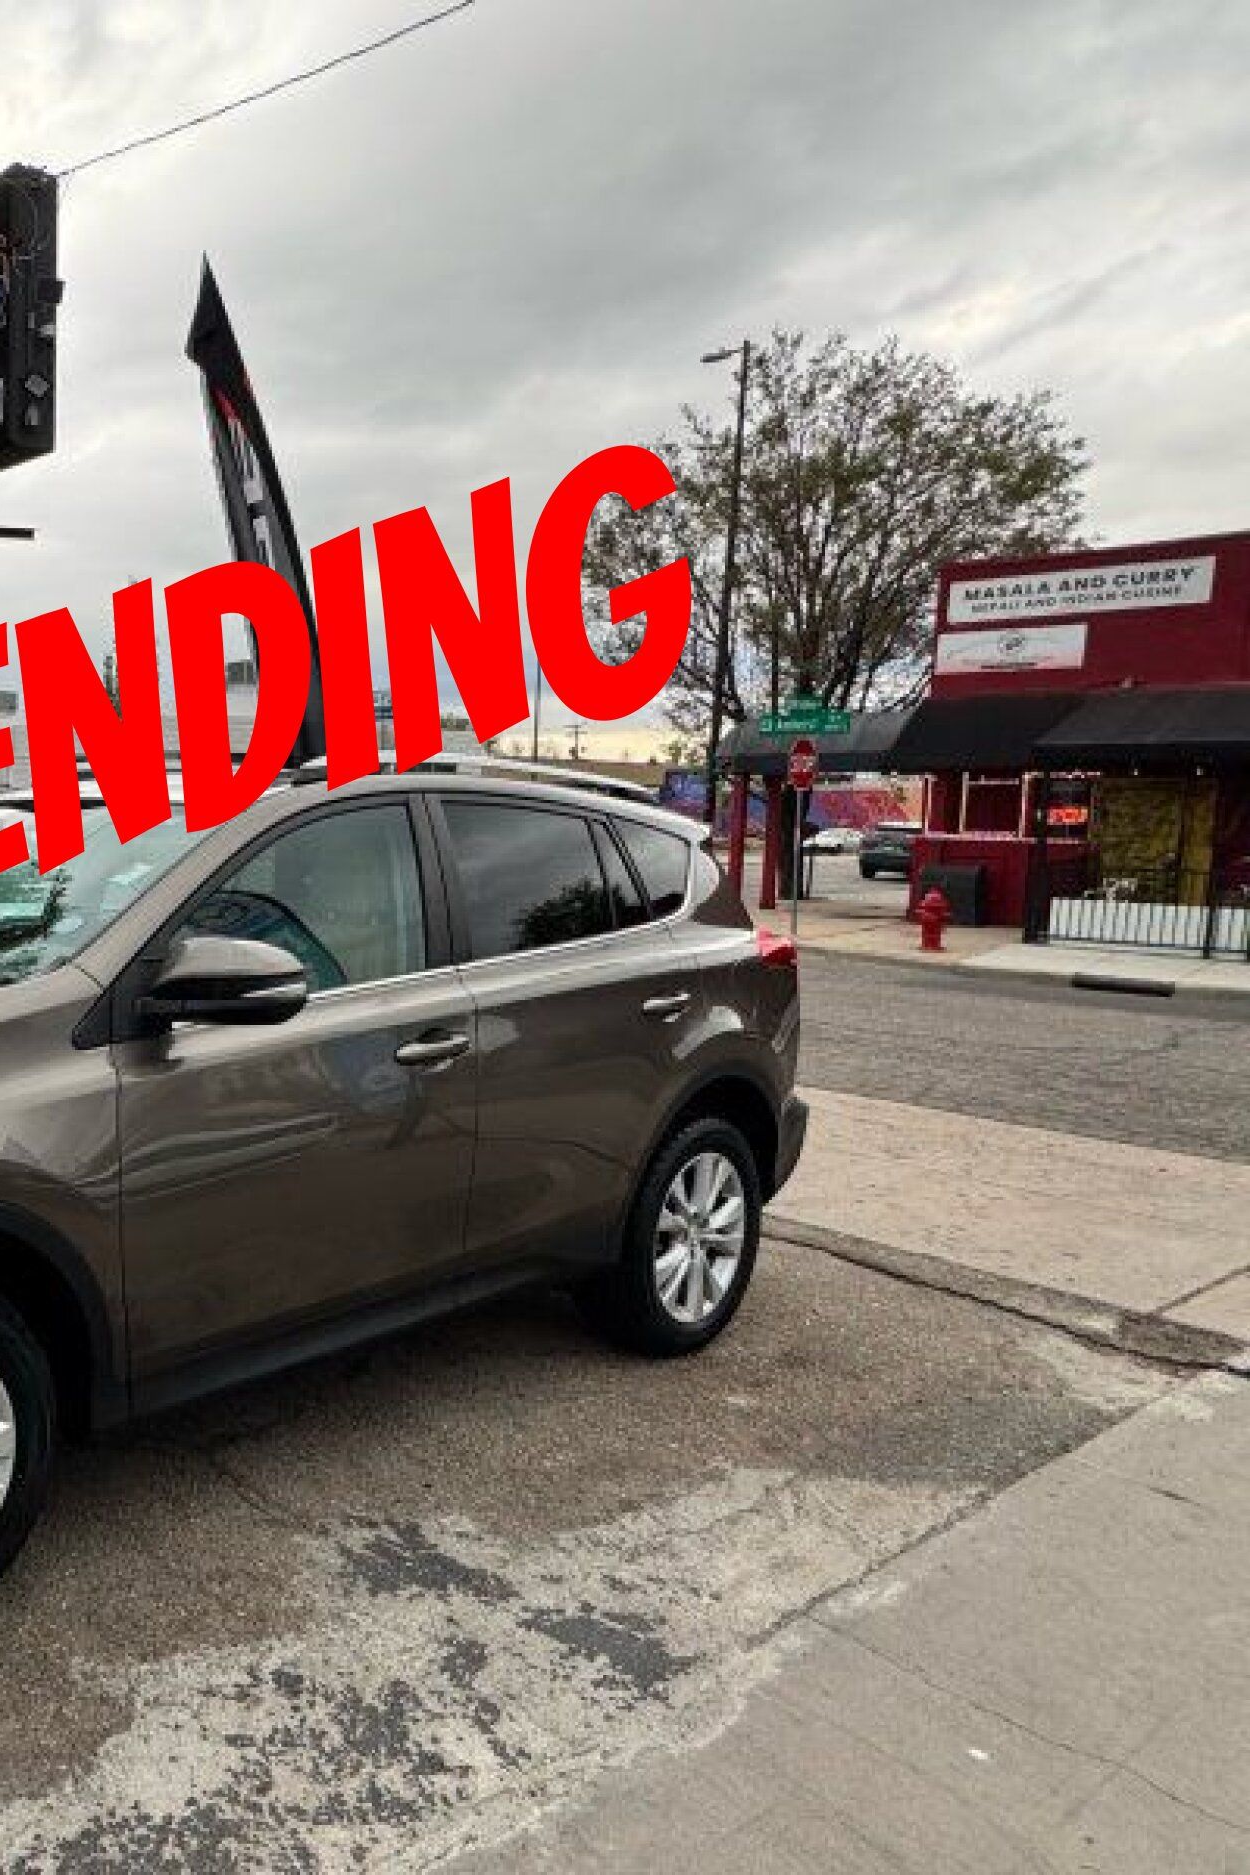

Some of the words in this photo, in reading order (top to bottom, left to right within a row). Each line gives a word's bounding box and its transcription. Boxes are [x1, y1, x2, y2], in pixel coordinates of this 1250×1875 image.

[964, 580, 1051, 601] MASALA
[1058, 575, 1107, 592] AND
[1112, 566, 1198, 589] CURRY
